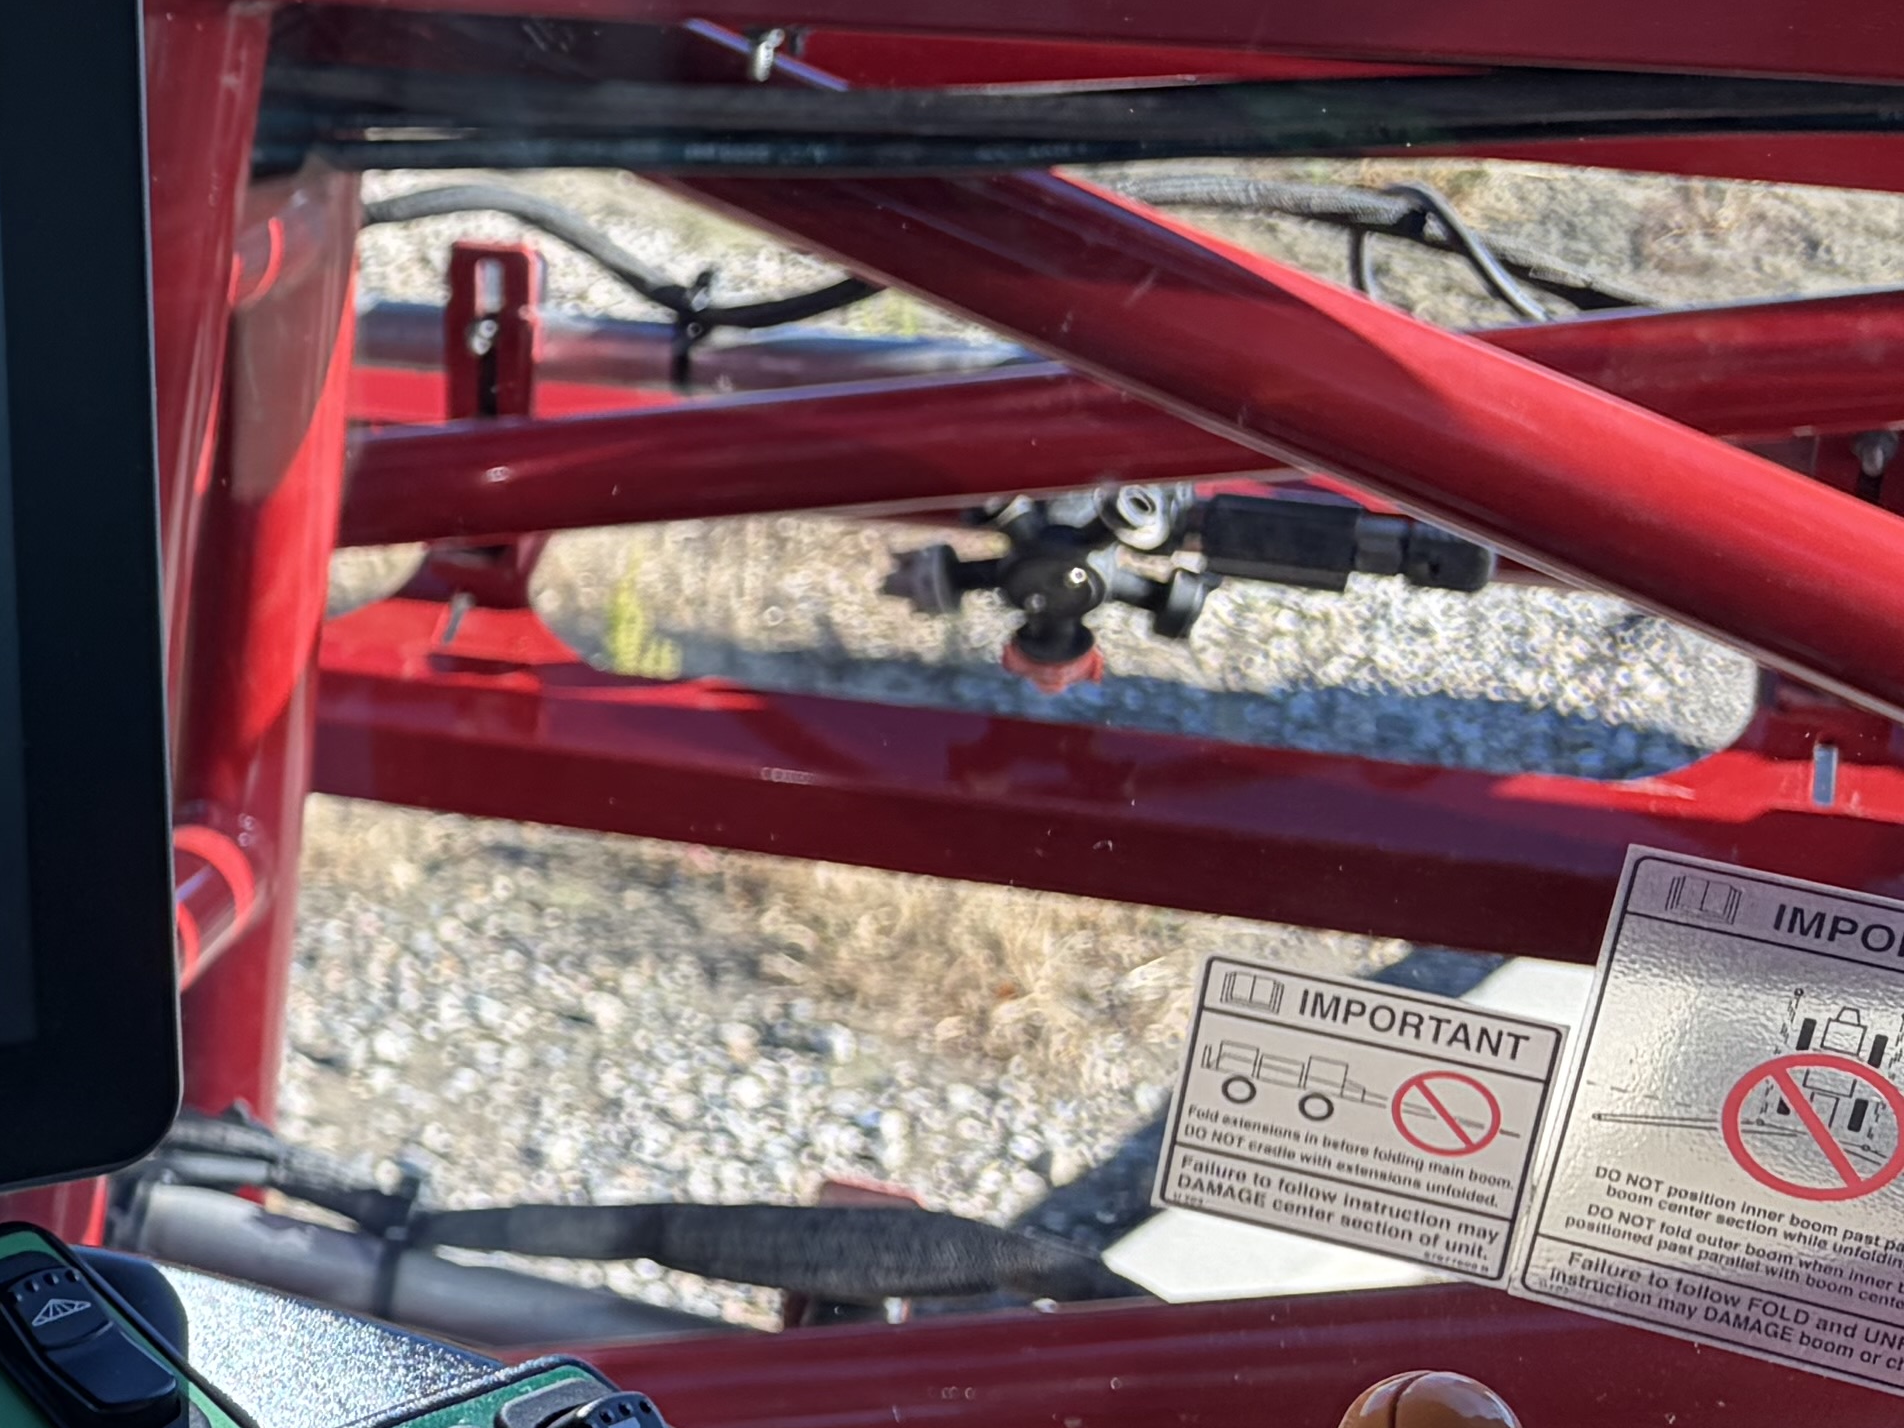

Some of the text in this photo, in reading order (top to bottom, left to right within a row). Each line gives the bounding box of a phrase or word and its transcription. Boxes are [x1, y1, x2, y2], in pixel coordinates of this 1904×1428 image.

[1774, 903, 1904, 959] IMPO
[1300, 989, 1530, 1060] IMPORTANT
[1185, 1124, 1497, 1207] DO NOT cradle with extensions unfolded.
[1188, 1105, 1513, 1189] Fold extensions in before folding main boom.
[1178, 1174, 1265, 1207] DAMAGE
[1273, 1200, 1334, 1222] center
[1341, 1215, 1412, 1242] section
[1419, 1234, 1439, 1247] of
[1446, 1240, 1486, 1260] unit.
[1182, 1155, 1499, 1244] Failure to follow instruction may
[1595, 1166, 1621, 1182] DO
[1626, 1173, 1664, 1192] NOT
[1667, 1186, 1735, 1211] position
[1741, 1202, 1784, 1222] inner
[1790, 1214, 1837, 1236] boom
[1842, 1229, 1880, 1252] past
[1607, 1184, 1904, 1272] boom center section while unfoldin
[1565, 1217, 1653, 1246] positioned
[1657, 1239, 1693, 1256] past
[1697, 1250, 1760, 1272] parallel
[1765, 1265, 1800, 1283] with
[1805, 1273, 1853, 1297] boom
[1588, 1204, 1613, 1219] DO
[1618, 1212, 1655, 1230] NOT
[1660, 1222, 1692, 1240] fold
[1696, 1234, 1741, 1251] outer
[1745, 1243, 1793, 1269] boom
[1798, 1254, 1843, 1278] when
[1849, 1268, 1893, 1290] inner
[1550, 1267, 1651, 1305] instruction
[1658, 1297, 1697, 1319] may
[1704, 1306, 1794, 1343] DAMAGE
[1799, 1331, 1854, 1358] boom
[1860, 1351, 1882, 1364] or
[1568, 1252, 1641, 1282] Failure
[1648, 1271, 1668, 1289] to
[1676, 1278, 1740, 1307] follow
[1748, 1297, 1809, 1325] FOLD
[1816, 1318, 1857, 1339] and
